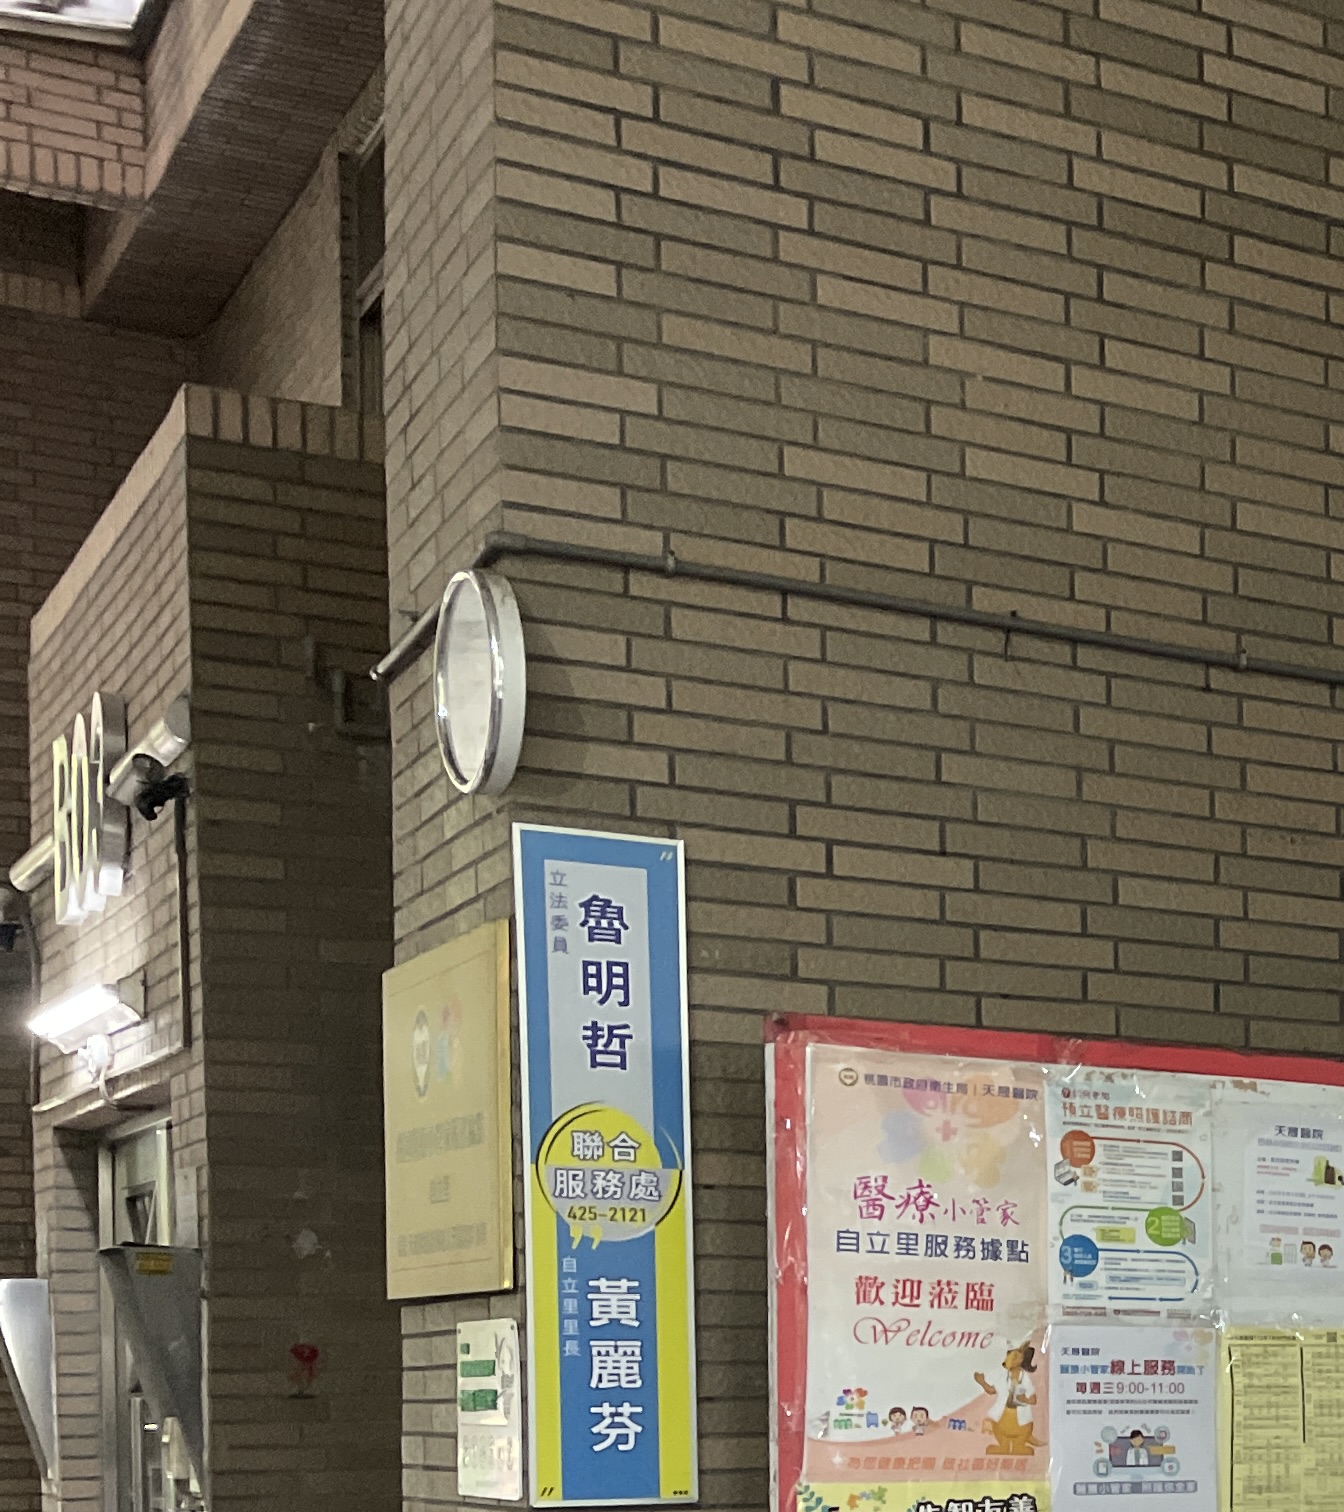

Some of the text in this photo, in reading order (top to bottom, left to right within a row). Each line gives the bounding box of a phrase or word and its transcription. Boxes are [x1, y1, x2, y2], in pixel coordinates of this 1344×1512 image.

[549, 869, 569, 954] 立法委員
[578, 894, 633, 1071] 魯明哲
[571, 1130, 641, 1162] 聯合
[554, 1168, 661, 1201] 服務處
[853, 1175, 1020, 1227] 醫療小管家
[568, 1205, 646, 1222] 425-2121
[836, 1229, 1029, 1263] 自立里服務據點
[562, 1256, 580, 1356] 自立里里長
[854, 1275, 994, 1312] 歡迎蒞臨
[853, 1316, 994, 1349] Welcome
[587, 1278, 643, 1451] 黃麗芬
